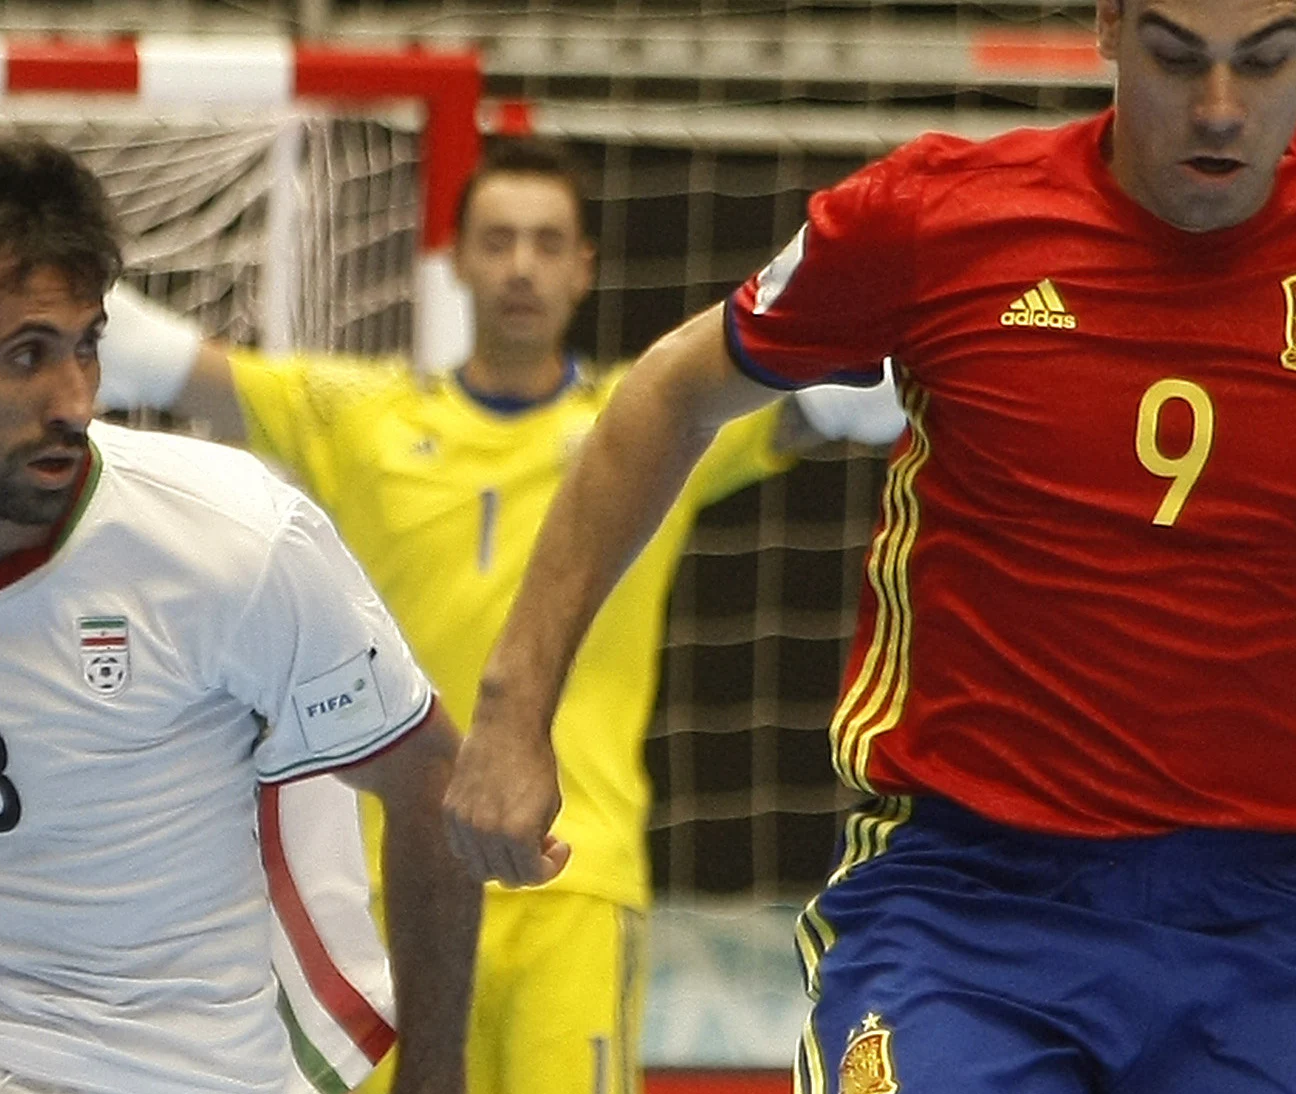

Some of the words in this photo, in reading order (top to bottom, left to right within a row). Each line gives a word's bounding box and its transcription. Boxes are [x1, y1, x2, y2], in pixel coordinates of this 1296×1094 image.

[1000, 308, 1077, 329] adidas
[1136, 379, 1213, 526] 9
[477, 488, 501, 573] 1
[306, 694, 353, 717] FIFA
